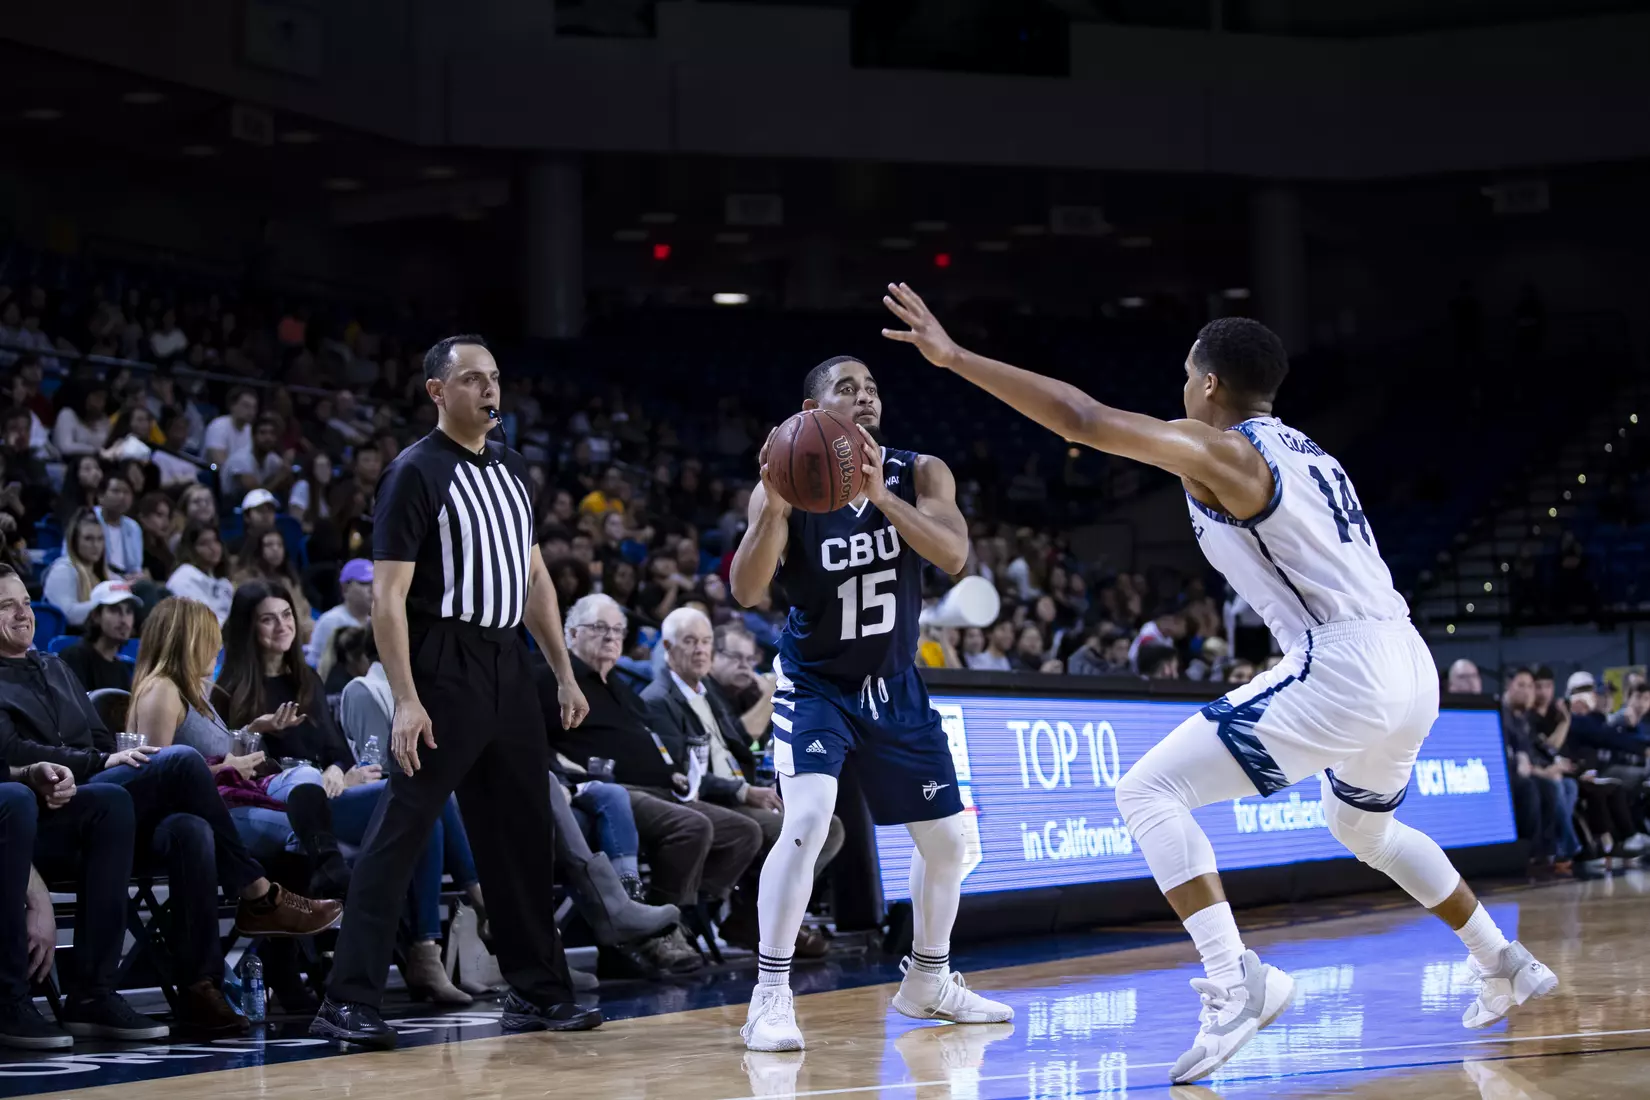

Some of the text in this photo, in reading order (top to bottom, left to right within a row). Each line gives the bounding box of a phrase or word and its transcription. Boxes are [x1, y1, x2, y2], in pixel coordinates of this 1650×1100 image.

[832, 434, 856, 503] Wilson
[1308, 465, 1371, 547] 14
[821, 524, 901, 572] CBU
[837, 568, 897, 640] 15
[1006, 719, 1120, 790] TOP 10
[1415, 758, 1490, 796] UCI Health
[1020, 816, 1133, 861] in California
[1233, 798, 1259, 834] for
